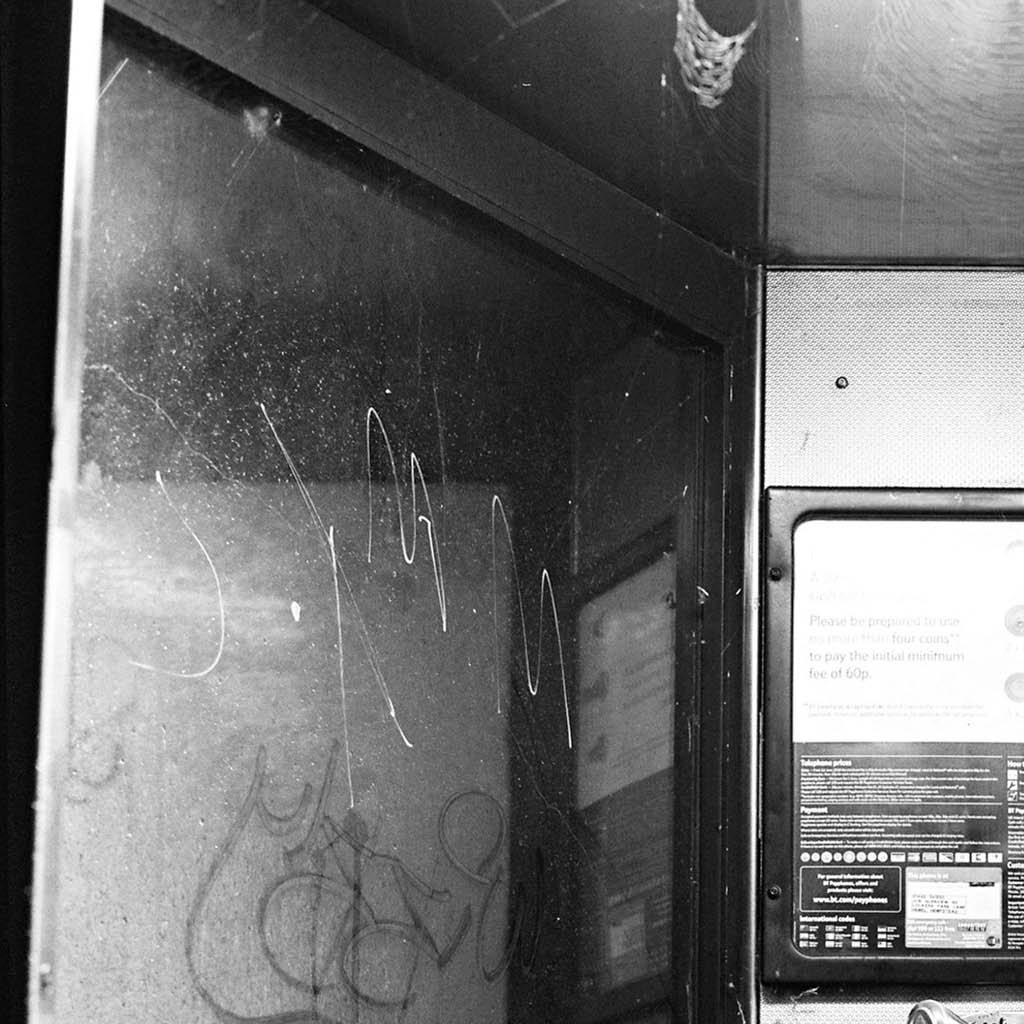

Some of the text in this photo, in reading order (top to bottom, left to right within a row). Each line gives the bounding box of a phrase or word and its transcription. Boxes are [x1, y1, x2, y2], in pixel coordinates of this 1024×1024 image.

[808, 614, 961, 629] Please be prepared to use
[891, 632, 915, 645] four
[808, 650, 965, 664] to pay the initial minimum
[808, 667, 873, 681] fee of 60p.
[799, 759, 853, 769] Telephone prices
[1007, 759, 1022, 768] How
[799, 805, 829, 815] Payment
[799, 915, 856, 923] International codes
